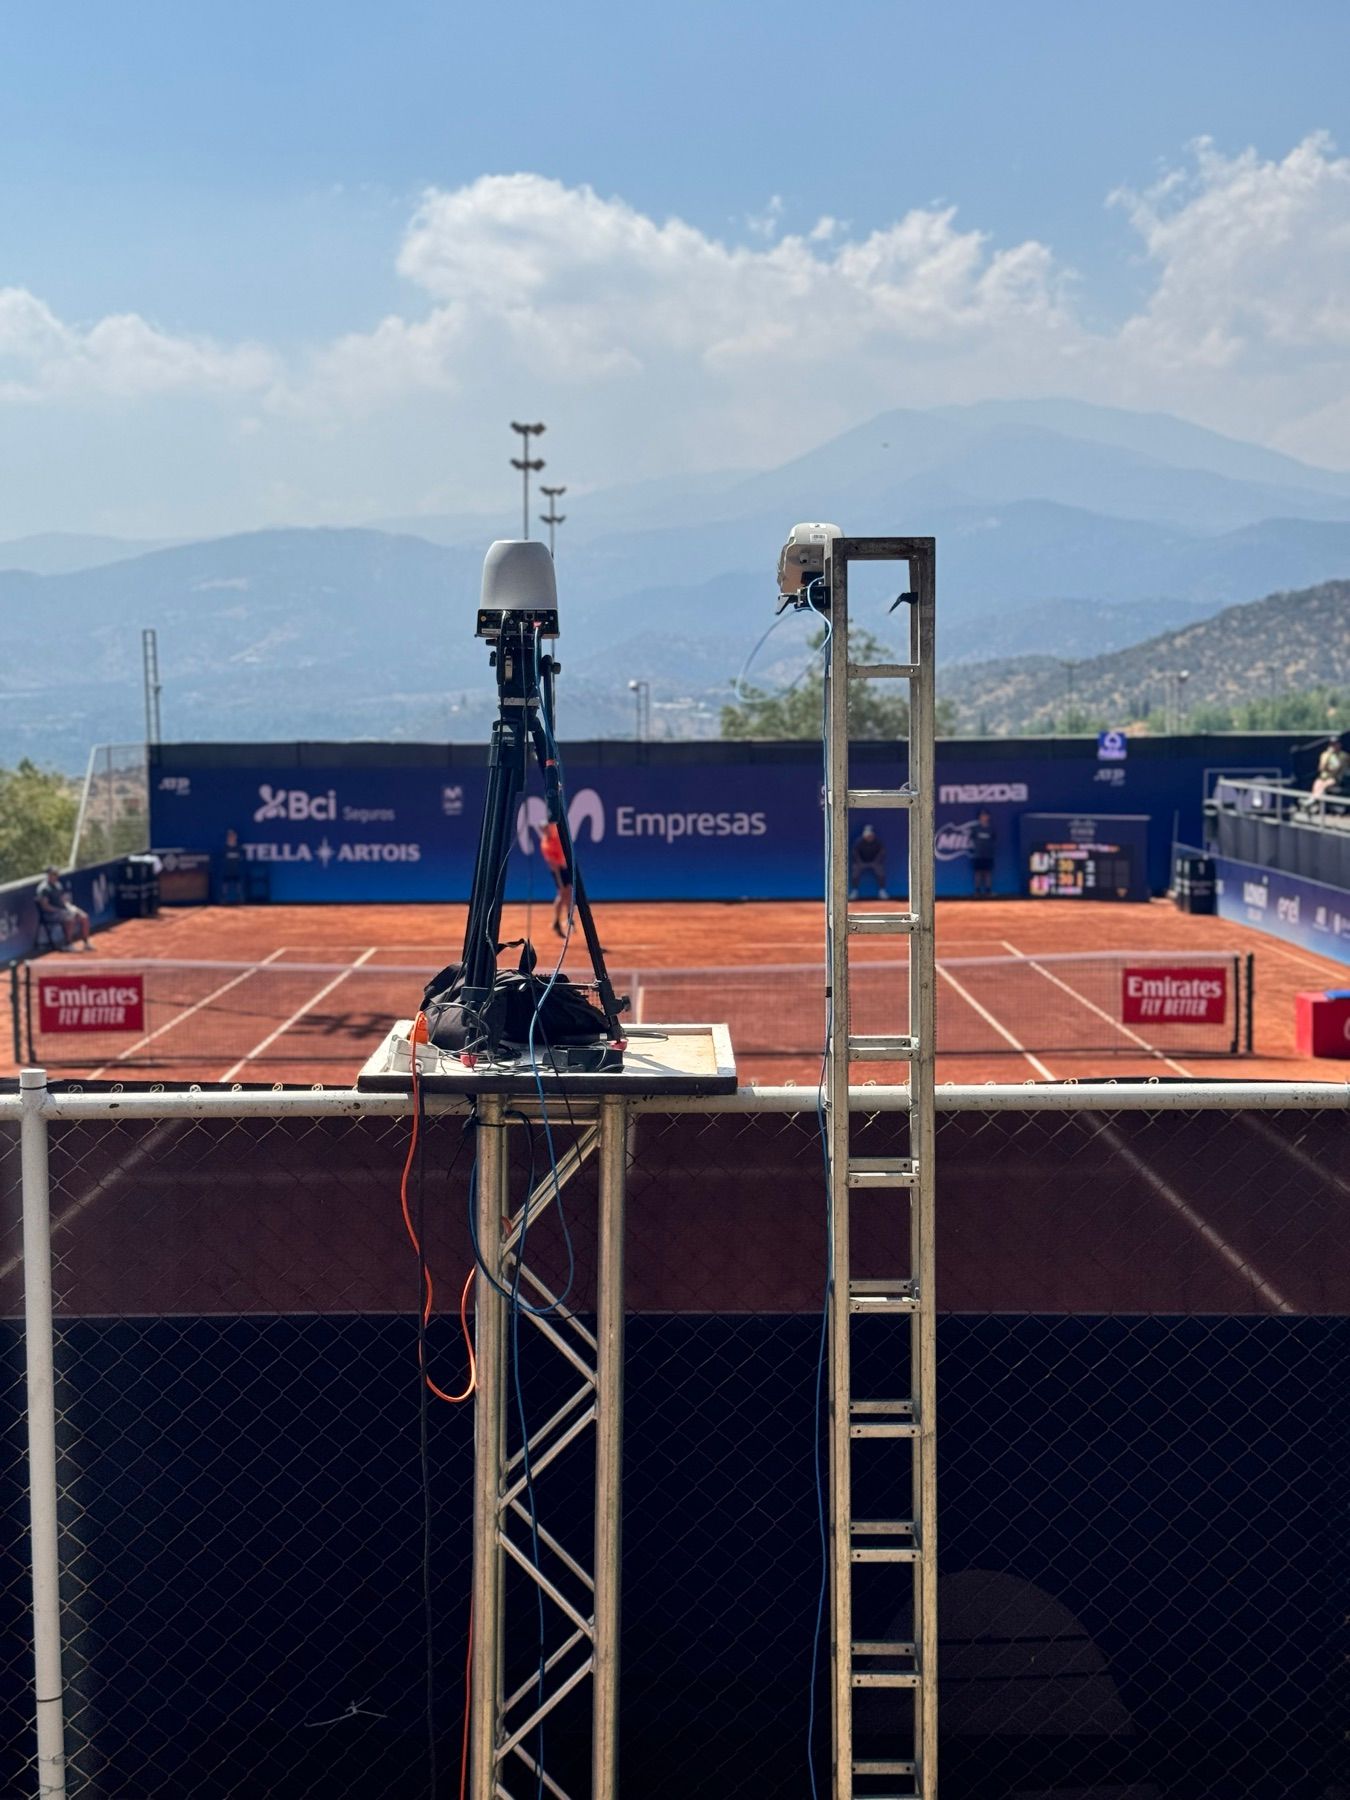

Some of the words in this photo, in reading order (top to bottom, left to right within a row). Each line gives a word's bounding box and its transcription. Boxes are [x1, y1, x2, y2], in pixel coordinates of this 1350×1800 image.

[939, 783, 1028, 804] mazda
[287, 789, 337, 821] Bci
[343, 806, 395, 823] Seguros
[616, 806, 767, 844] Empresas
[242, 843, 313, 862] TELLA
[337, 843, 422, 862] ARTOIS
[43, 984, 139, 1008] Emirates
[1127, 976, 1222, 998] Emirates
[58, 1006, 80, 1025] FLY
[81, 1006, 126, 1025] BETTER
[1140, 999, 1162, 1016] FLY
[1163, 999, 1208, 1016] BETTER
